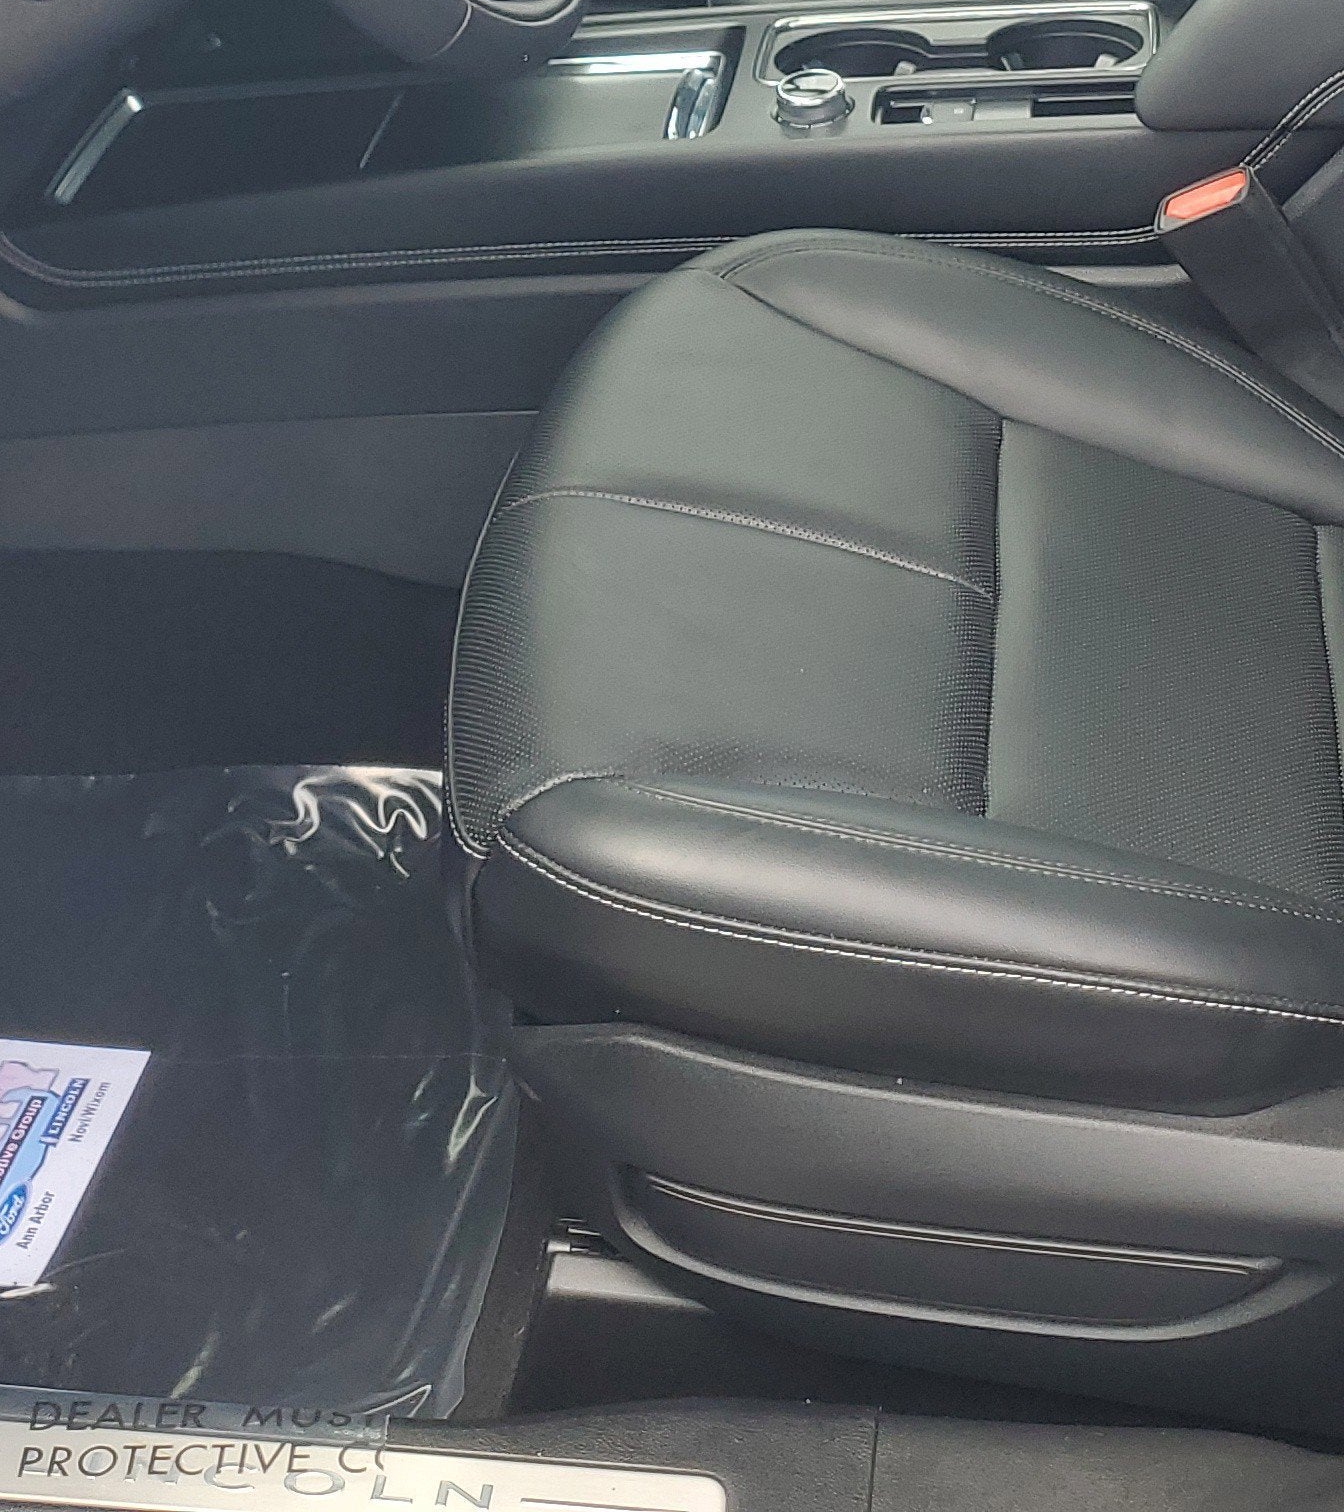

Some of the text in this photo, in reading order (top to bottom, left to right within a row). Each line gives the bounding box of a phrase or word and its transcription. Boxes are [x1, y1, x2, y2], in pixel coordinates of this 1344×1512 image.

[11, 1097, 46, 1140] Group
[49, 1078, 89, 1137] LINCOLN
[67, 1080, 111, 1144] Novi/Wixom
[16, 1190, 55, 1250] Ann Arbor
[28, 1400, 207, 1432] DEALER
[18, 1441, 311, 1478] PROTECTIVE
